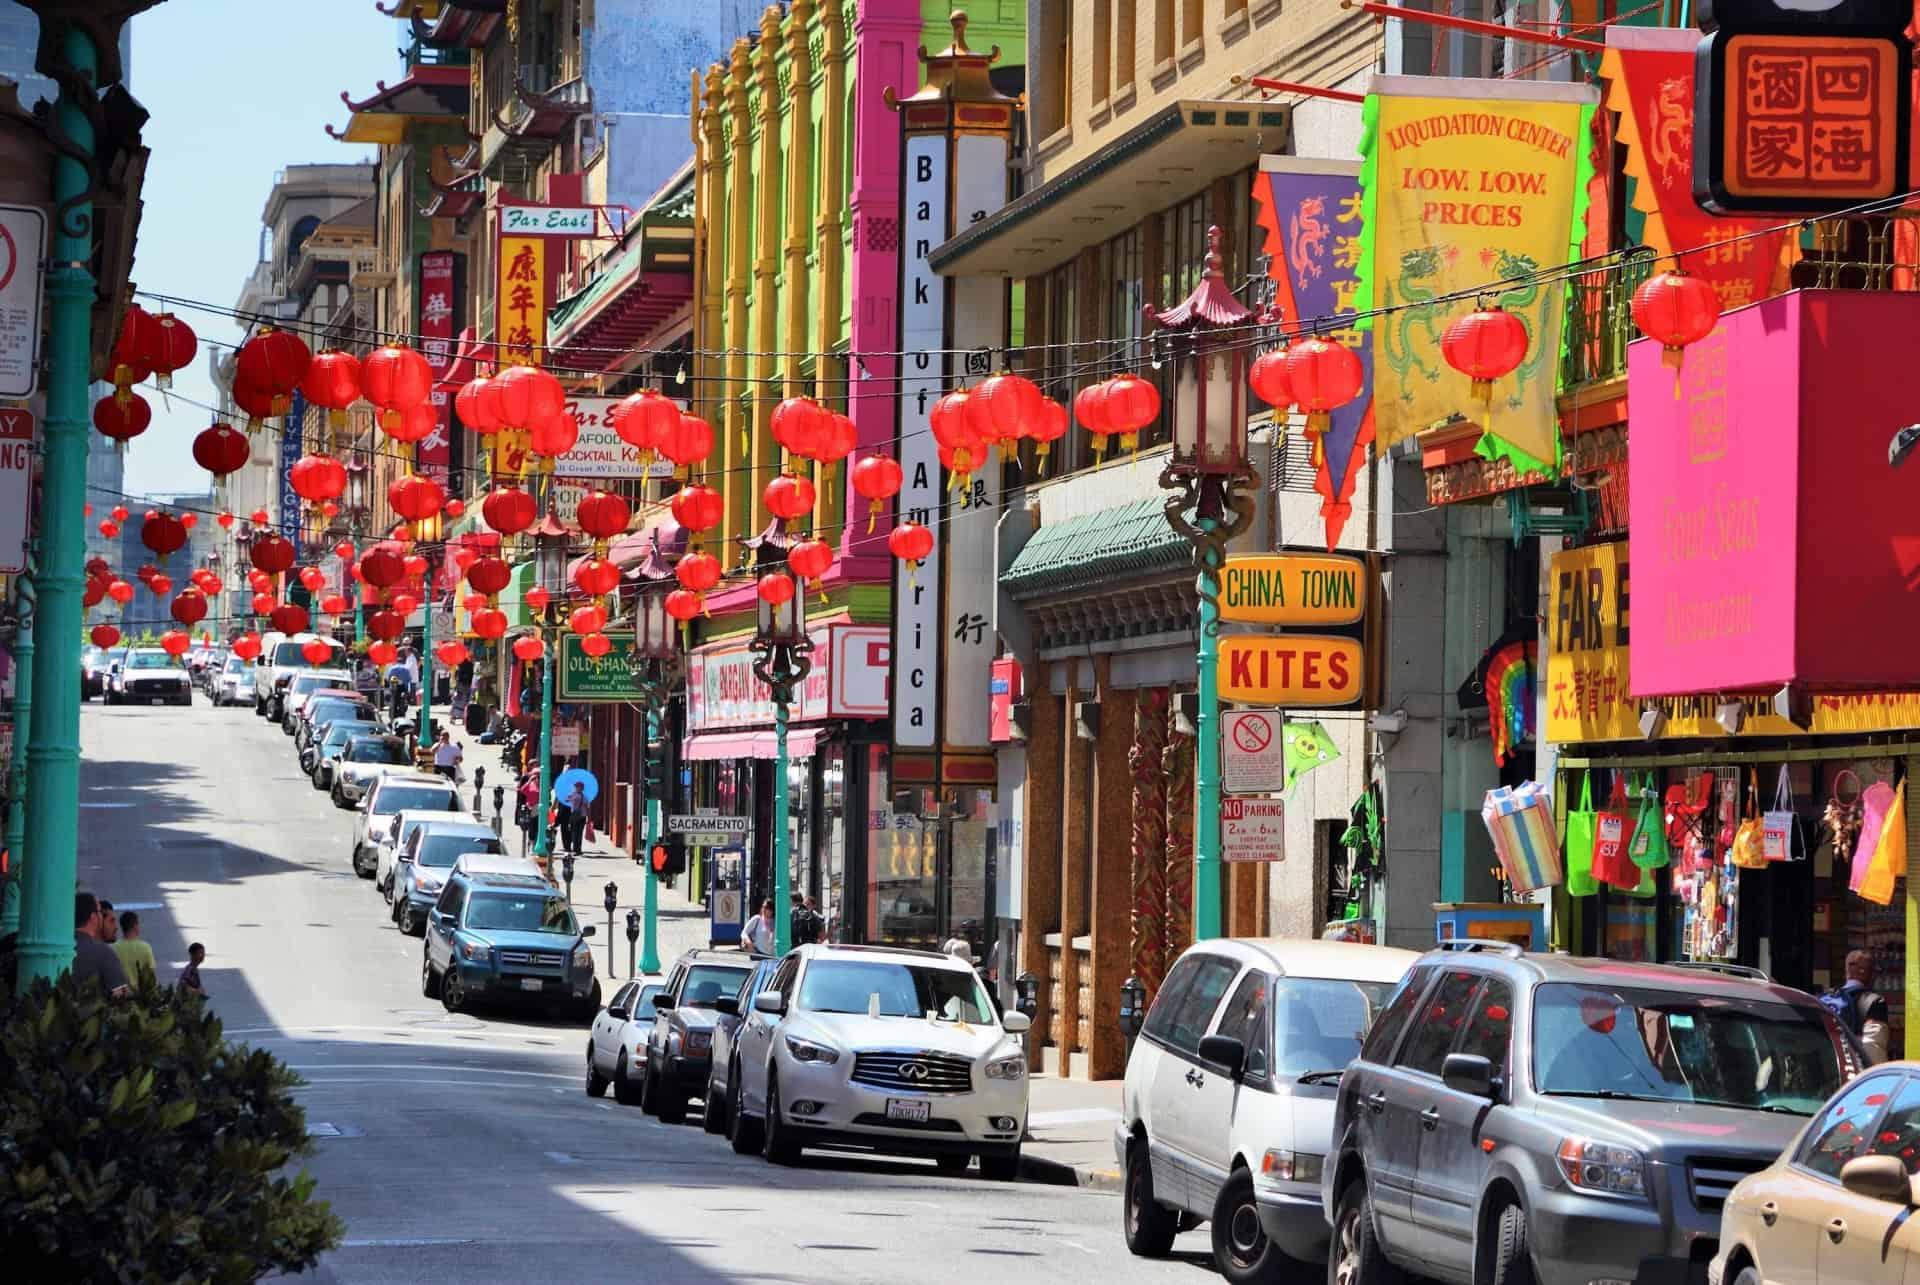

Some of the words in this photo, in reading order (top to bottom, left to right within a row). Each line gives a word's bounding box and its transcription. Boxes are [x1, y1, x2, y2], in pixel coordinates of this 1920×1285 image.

[1385, 113, 1504, 151] LIQUIDATION
[1506, 118, 1572, 160] CENTER
[1402, 167, 1469, 192] LOW.
[1479, 170, 1547, 195] LOW.
[507, 210, 539, 229] Far
[546, 210, 588, 229] East
[1423, 201, 1523, 228] PRICES
[910, 462, 929, 726] Amrica
[1226, 569, 1285, 608] CHINA
[1301, 570, 1356, 609] TOWN
[1557, 567, 1604, 653] FAR
[569, 658, 594, 672] OLD
[1230, 649, 1350, 690] KITES
[1224, 801, 1241, 817] NO
[1244, 804, 1281, 816] PARKING
[670, 818, 745, 830] SACRAMENTO
